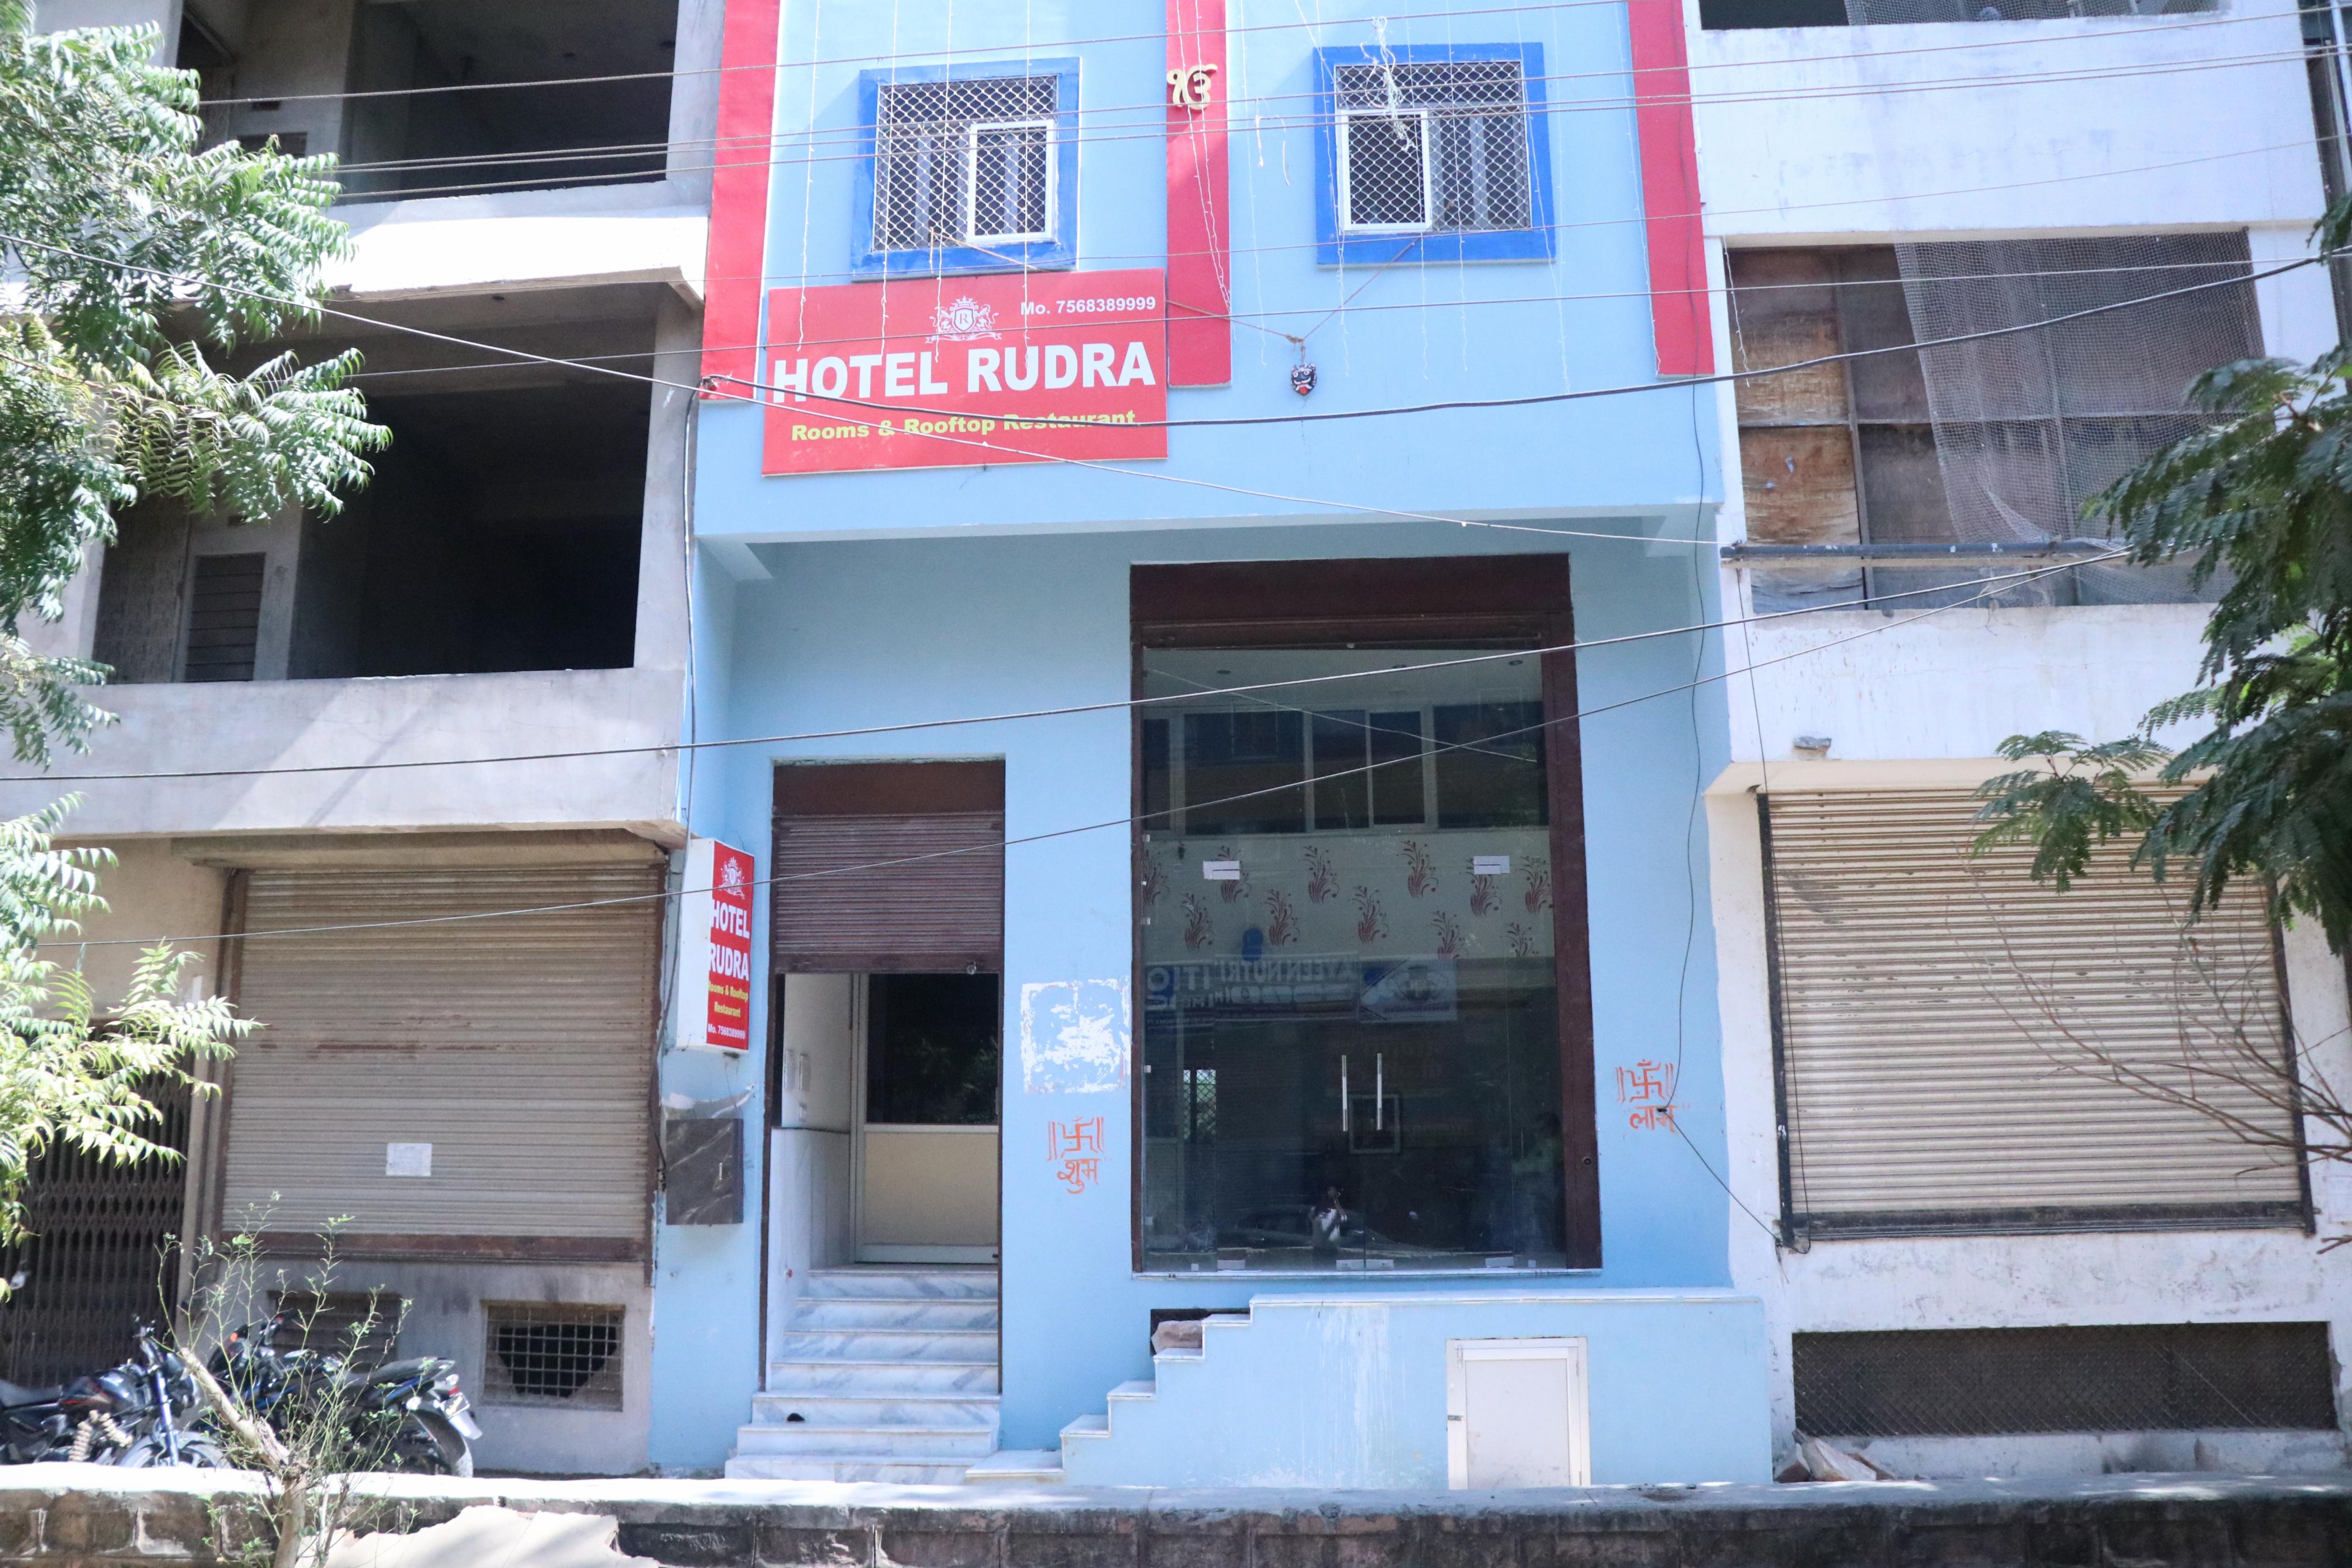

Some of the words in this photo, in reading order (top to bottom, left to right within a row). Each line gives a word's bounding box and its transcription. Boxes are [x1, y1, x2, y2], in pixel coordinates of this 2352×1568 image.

[1021, 302, 1050, 315] Mo.
[1056, 296, 1156, 313] 7568389999
[773, 351, 948, 403] HOTEL
[968, 342, 1156, 393] RUDRA
[792, 424, 869, 441] Rooms
[878, 420, 895, 436] &
[904, 417, 995, 435] Rooftop
[1004, 410, 1136, 430] Restaurant
[710, 899, 750, 939] HOTEL
[709, 942, 749, 981] RUDRA
[730, 986, 748, 1002] Rooftop
[714, 1001, 741, 1018] Restaurant
[707, 1024, 717, 1034] Mo.
